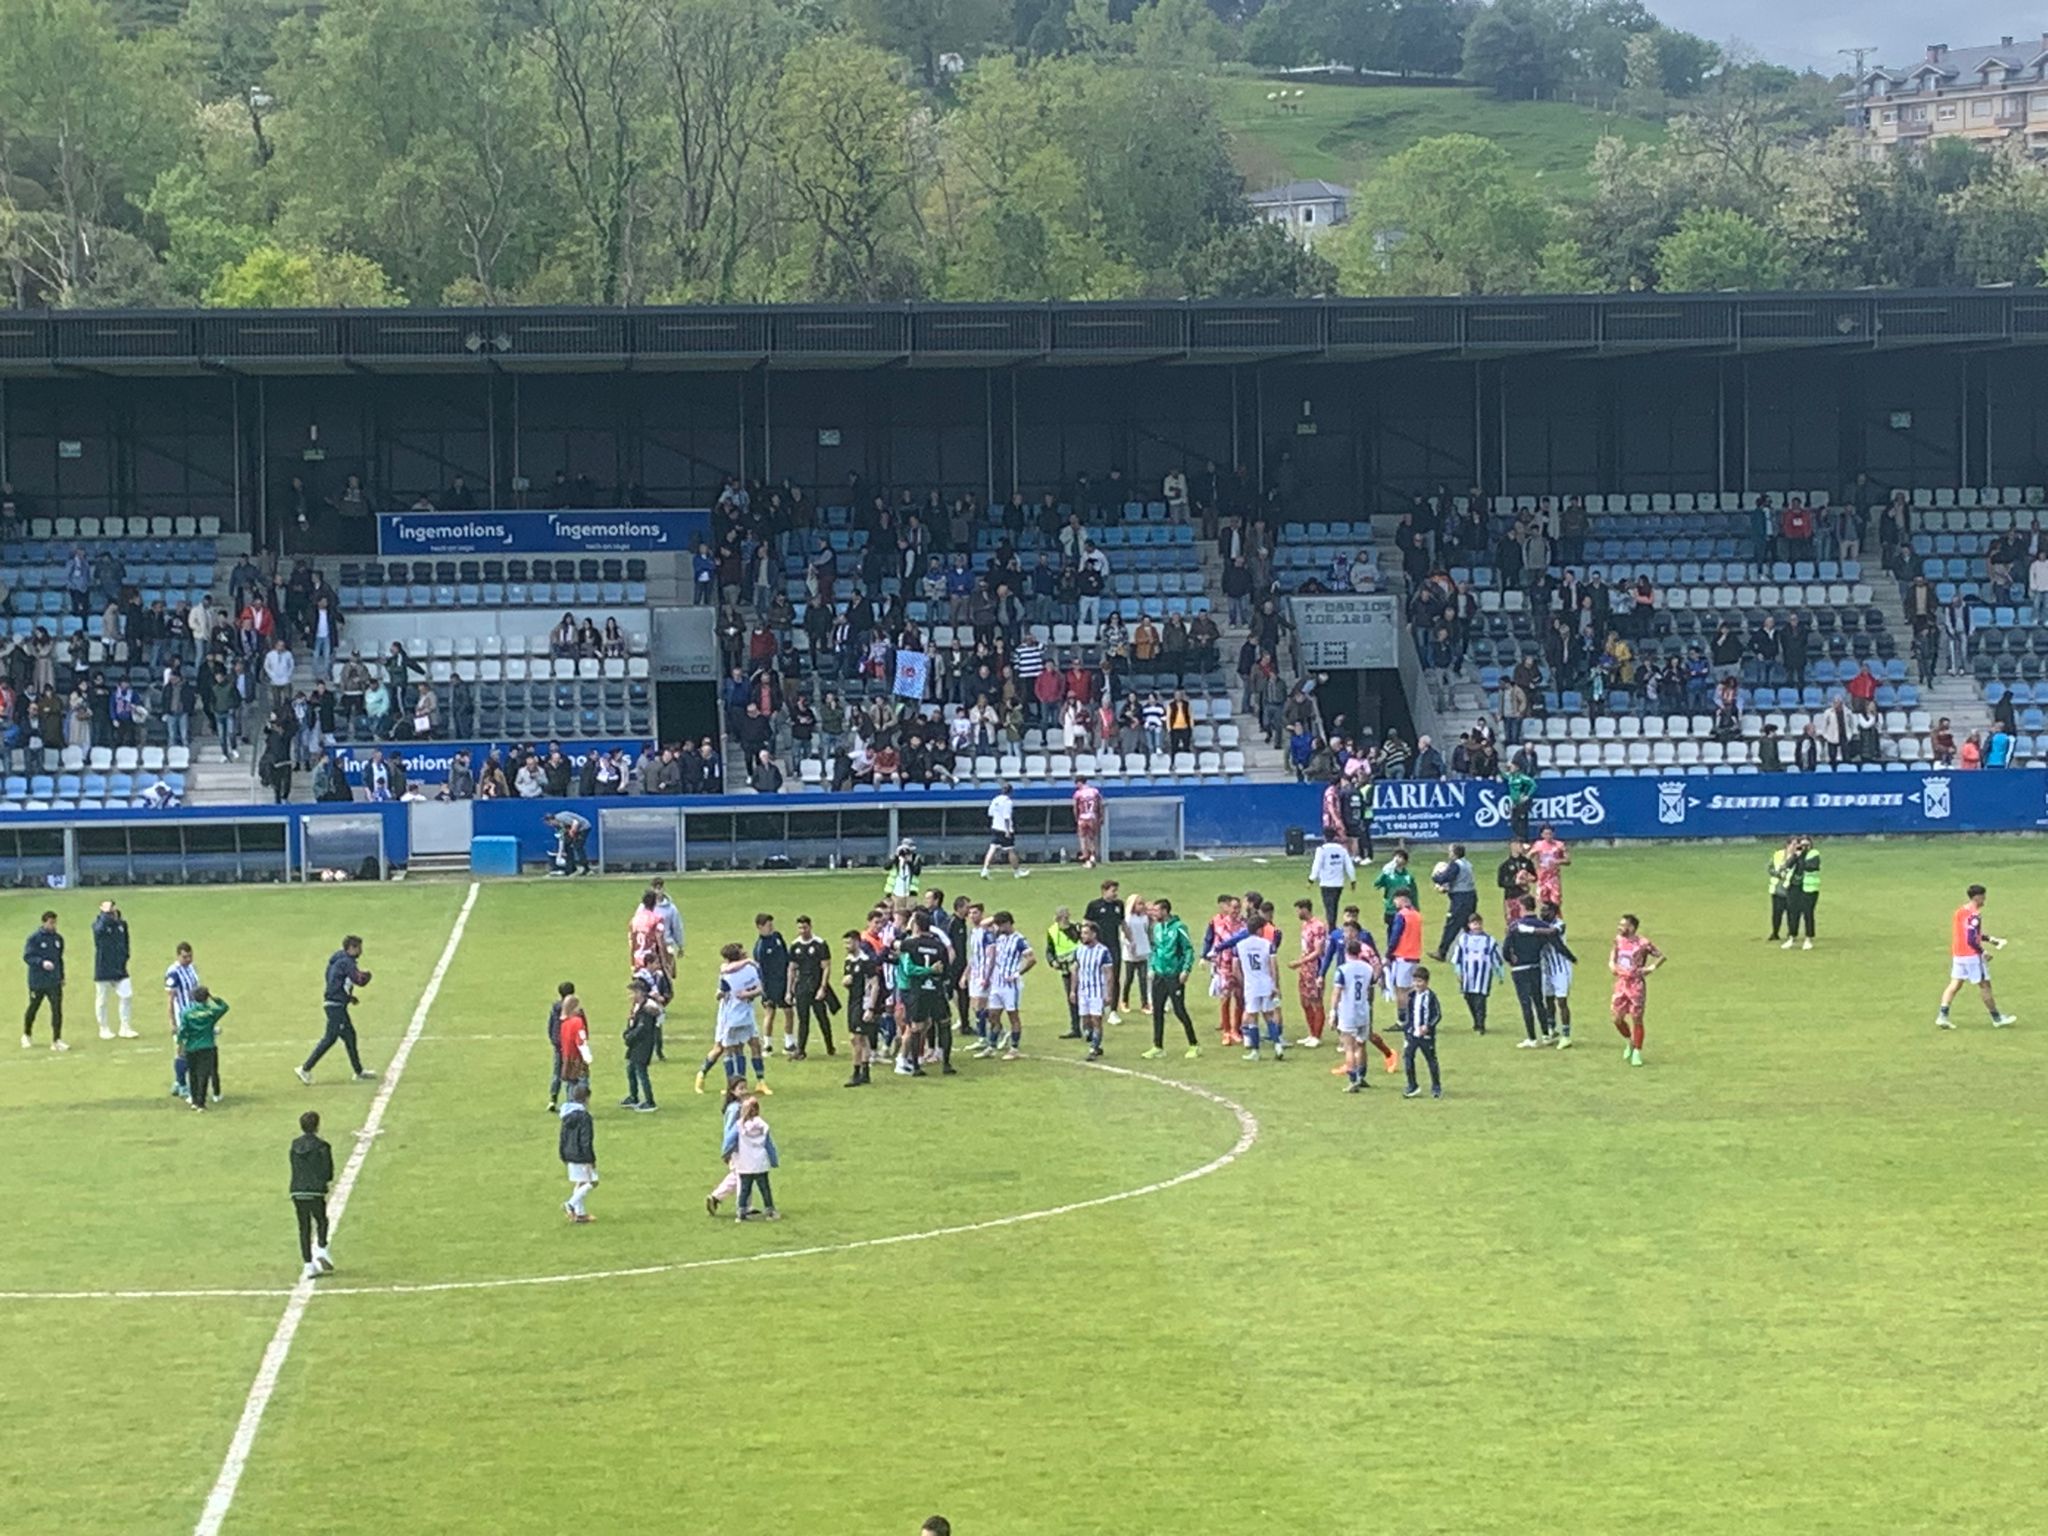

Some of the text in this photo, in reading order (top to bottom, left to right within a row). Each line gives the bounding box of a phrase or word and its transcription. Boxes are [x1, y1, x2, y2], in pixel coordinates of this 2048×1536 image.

[399, 523, 505, 542] ingemotions
[555, 521, 660, 539] ingemotions
[1475, 786, 1605, 827] SOARES
[1353, 980, 1362, 1001] 8
